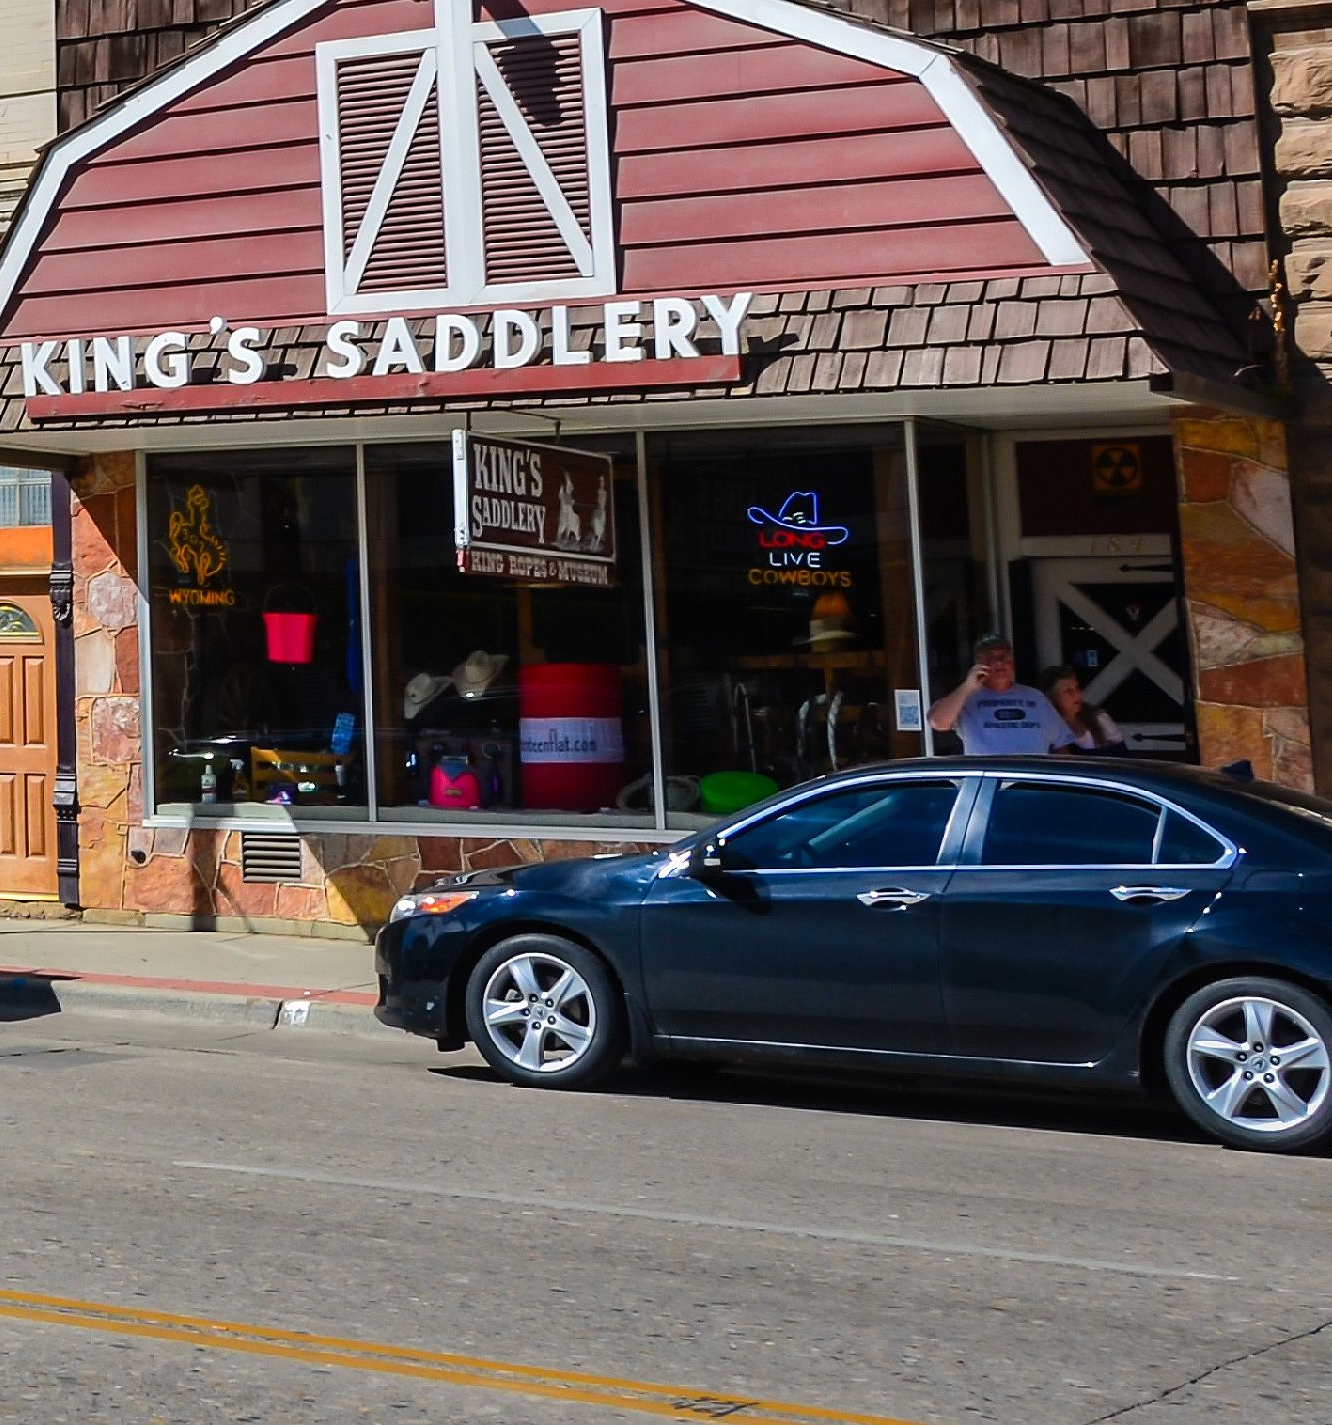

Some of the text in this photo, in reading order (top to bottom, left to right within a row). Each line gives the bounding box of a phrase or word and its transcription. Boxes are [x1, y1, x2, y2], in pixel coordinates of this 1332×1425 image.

[21, 292, 753, 398] KING'S SADDLERY
[473, 443, 543, 497] KING'S
[472, 494, 546, 544] SADDLERY
[758, 530, 826, 550] LONG
[471, 551, 504, 573] KING
[769, 552, 821, 568] LIVE
[748, 568, 852, 588] COWBOYS
[168, 588, 235, 606] WYOMING
